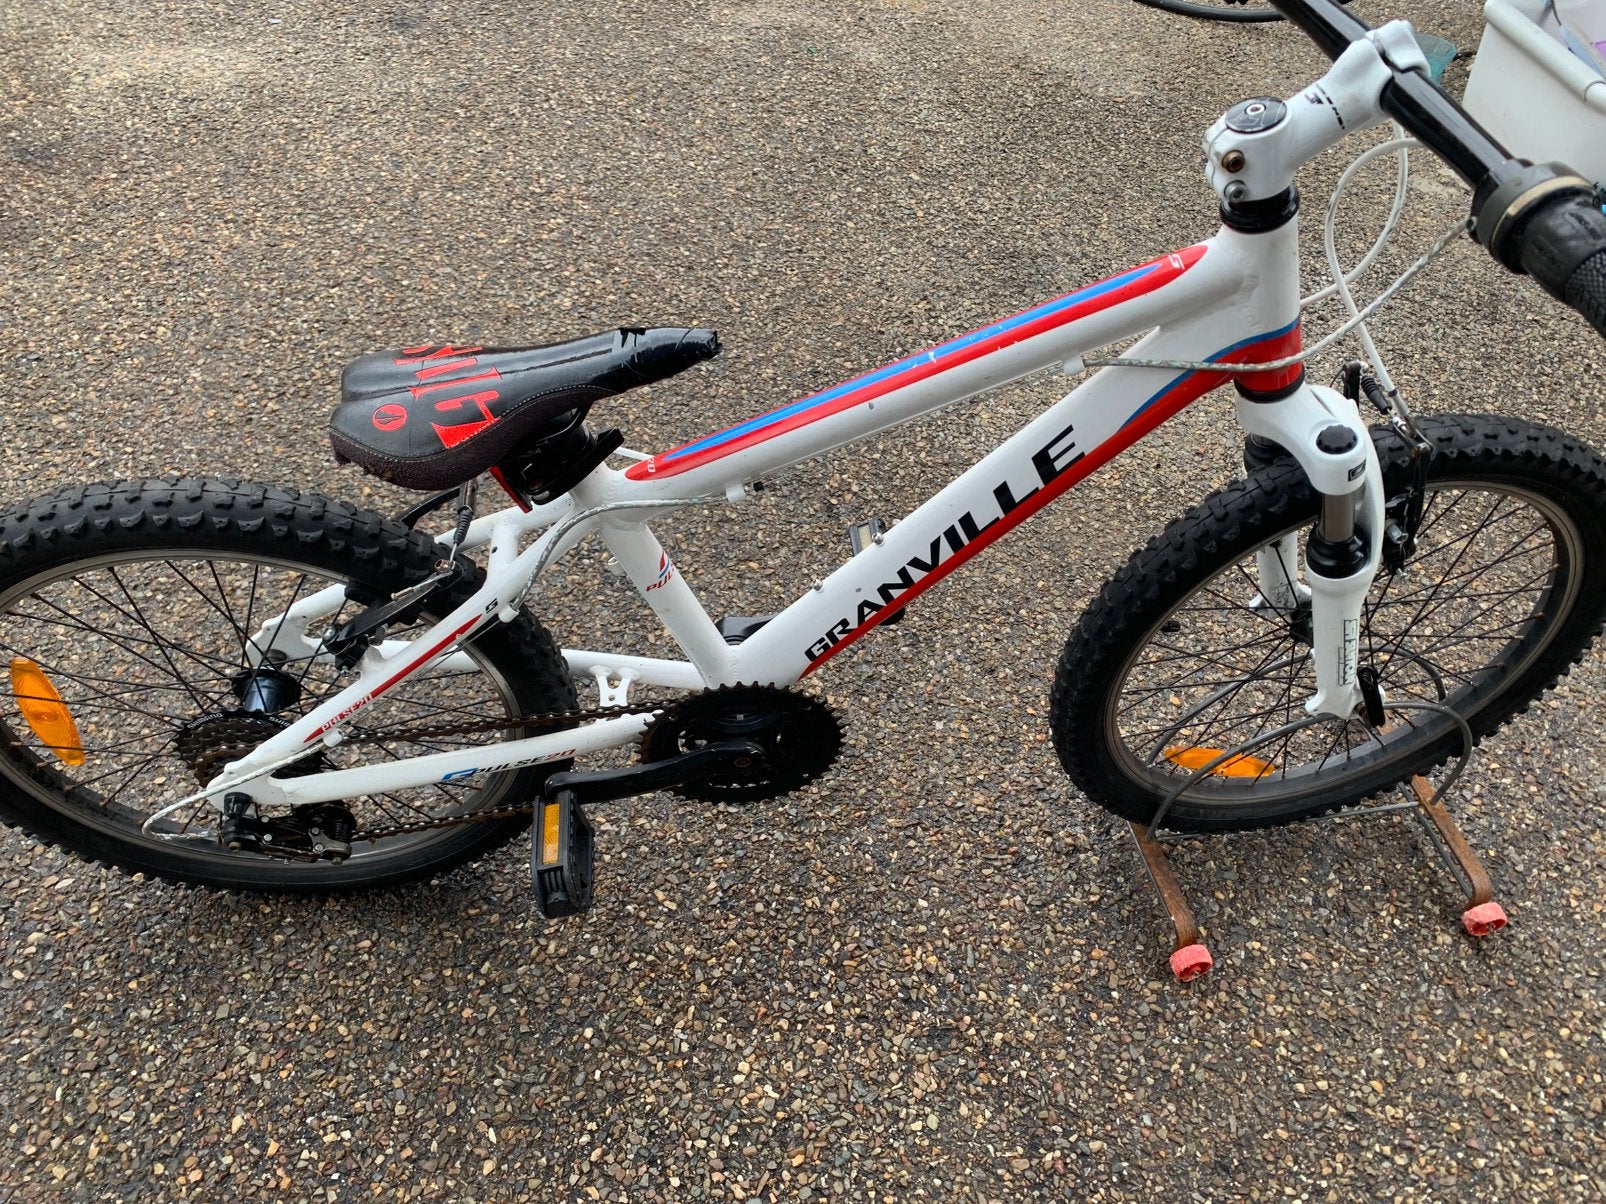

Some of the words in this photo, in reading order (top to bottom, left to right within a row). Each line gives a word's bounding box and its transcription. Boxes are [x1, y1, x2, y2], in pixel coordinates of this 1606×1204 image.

[804, 424, 1085, 662] GRANVILLE
[646, 566, 674, 592] PUL
[186, 712, 223, 730] SHIMANO
[321, 692, 374, 732] PULSE20
